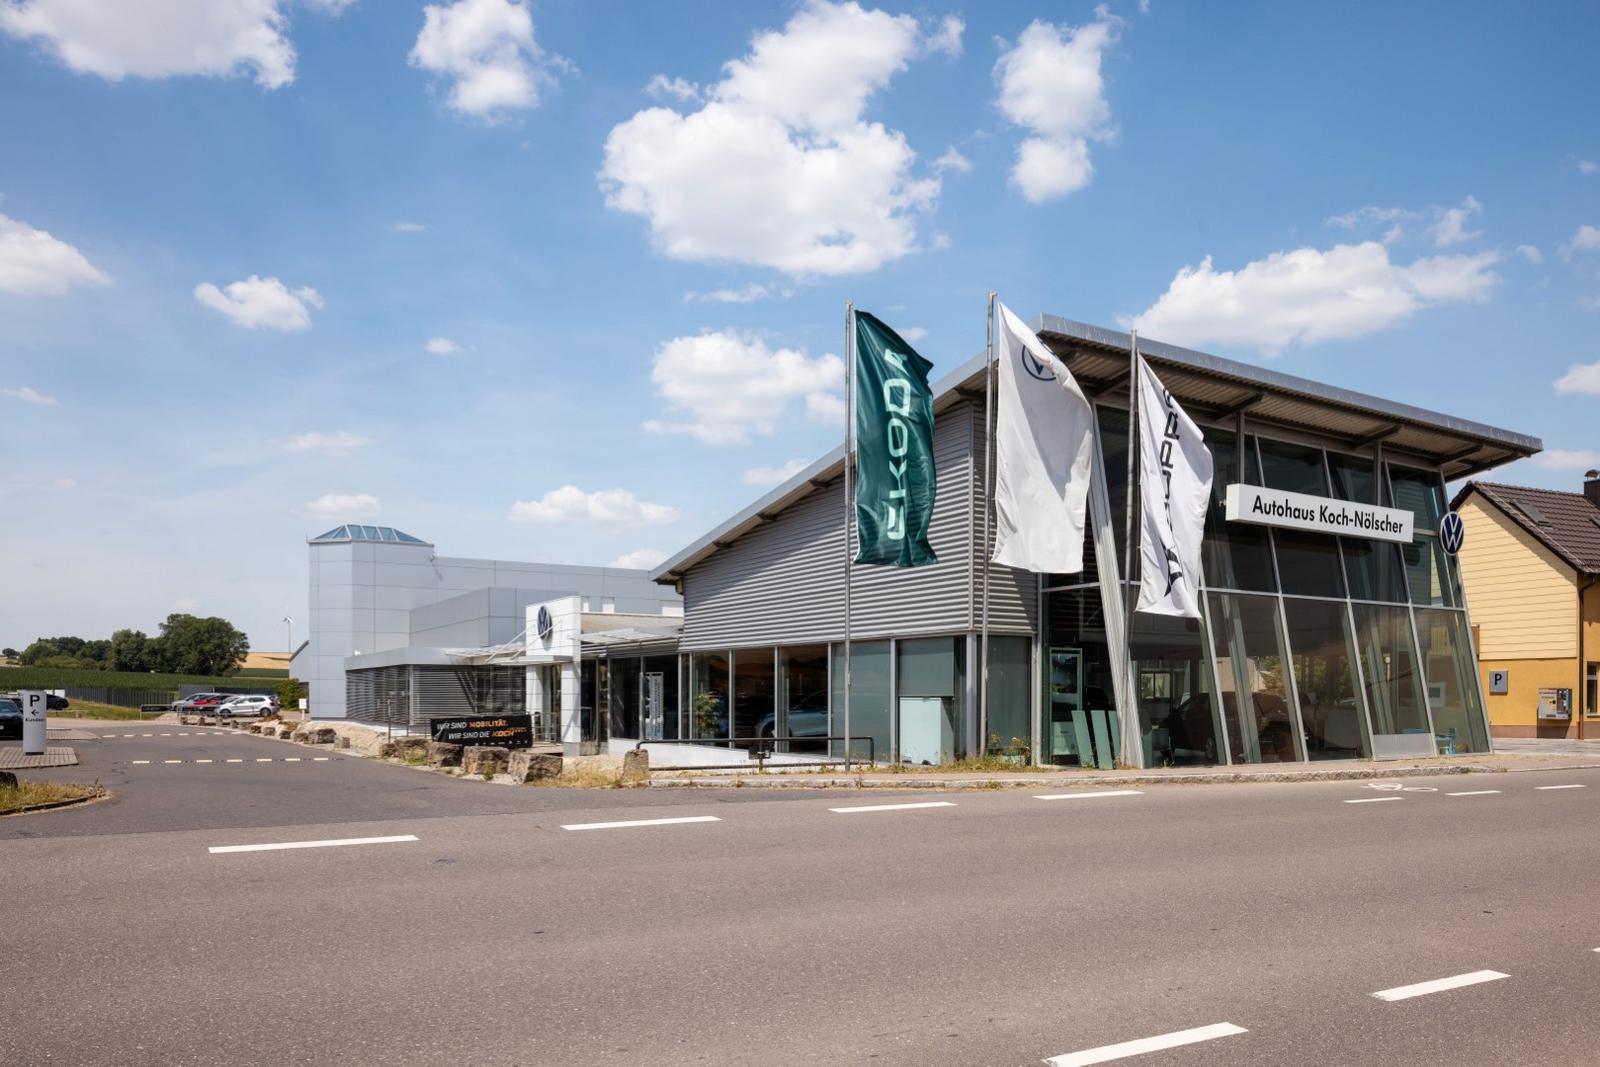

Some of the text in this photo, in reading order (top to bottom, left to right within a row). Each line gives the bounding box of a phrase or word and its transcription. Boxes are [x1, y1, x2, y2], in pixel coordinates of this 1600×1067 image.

[1252, 495, 1404, 534] Autohaus Koch-Nölscher
[1440, 512, 1464, 555] VW
[1494, 673, 1503, 686] P
[30, 694, 40, 707] P
[451, 721, 467, 729] SIND
